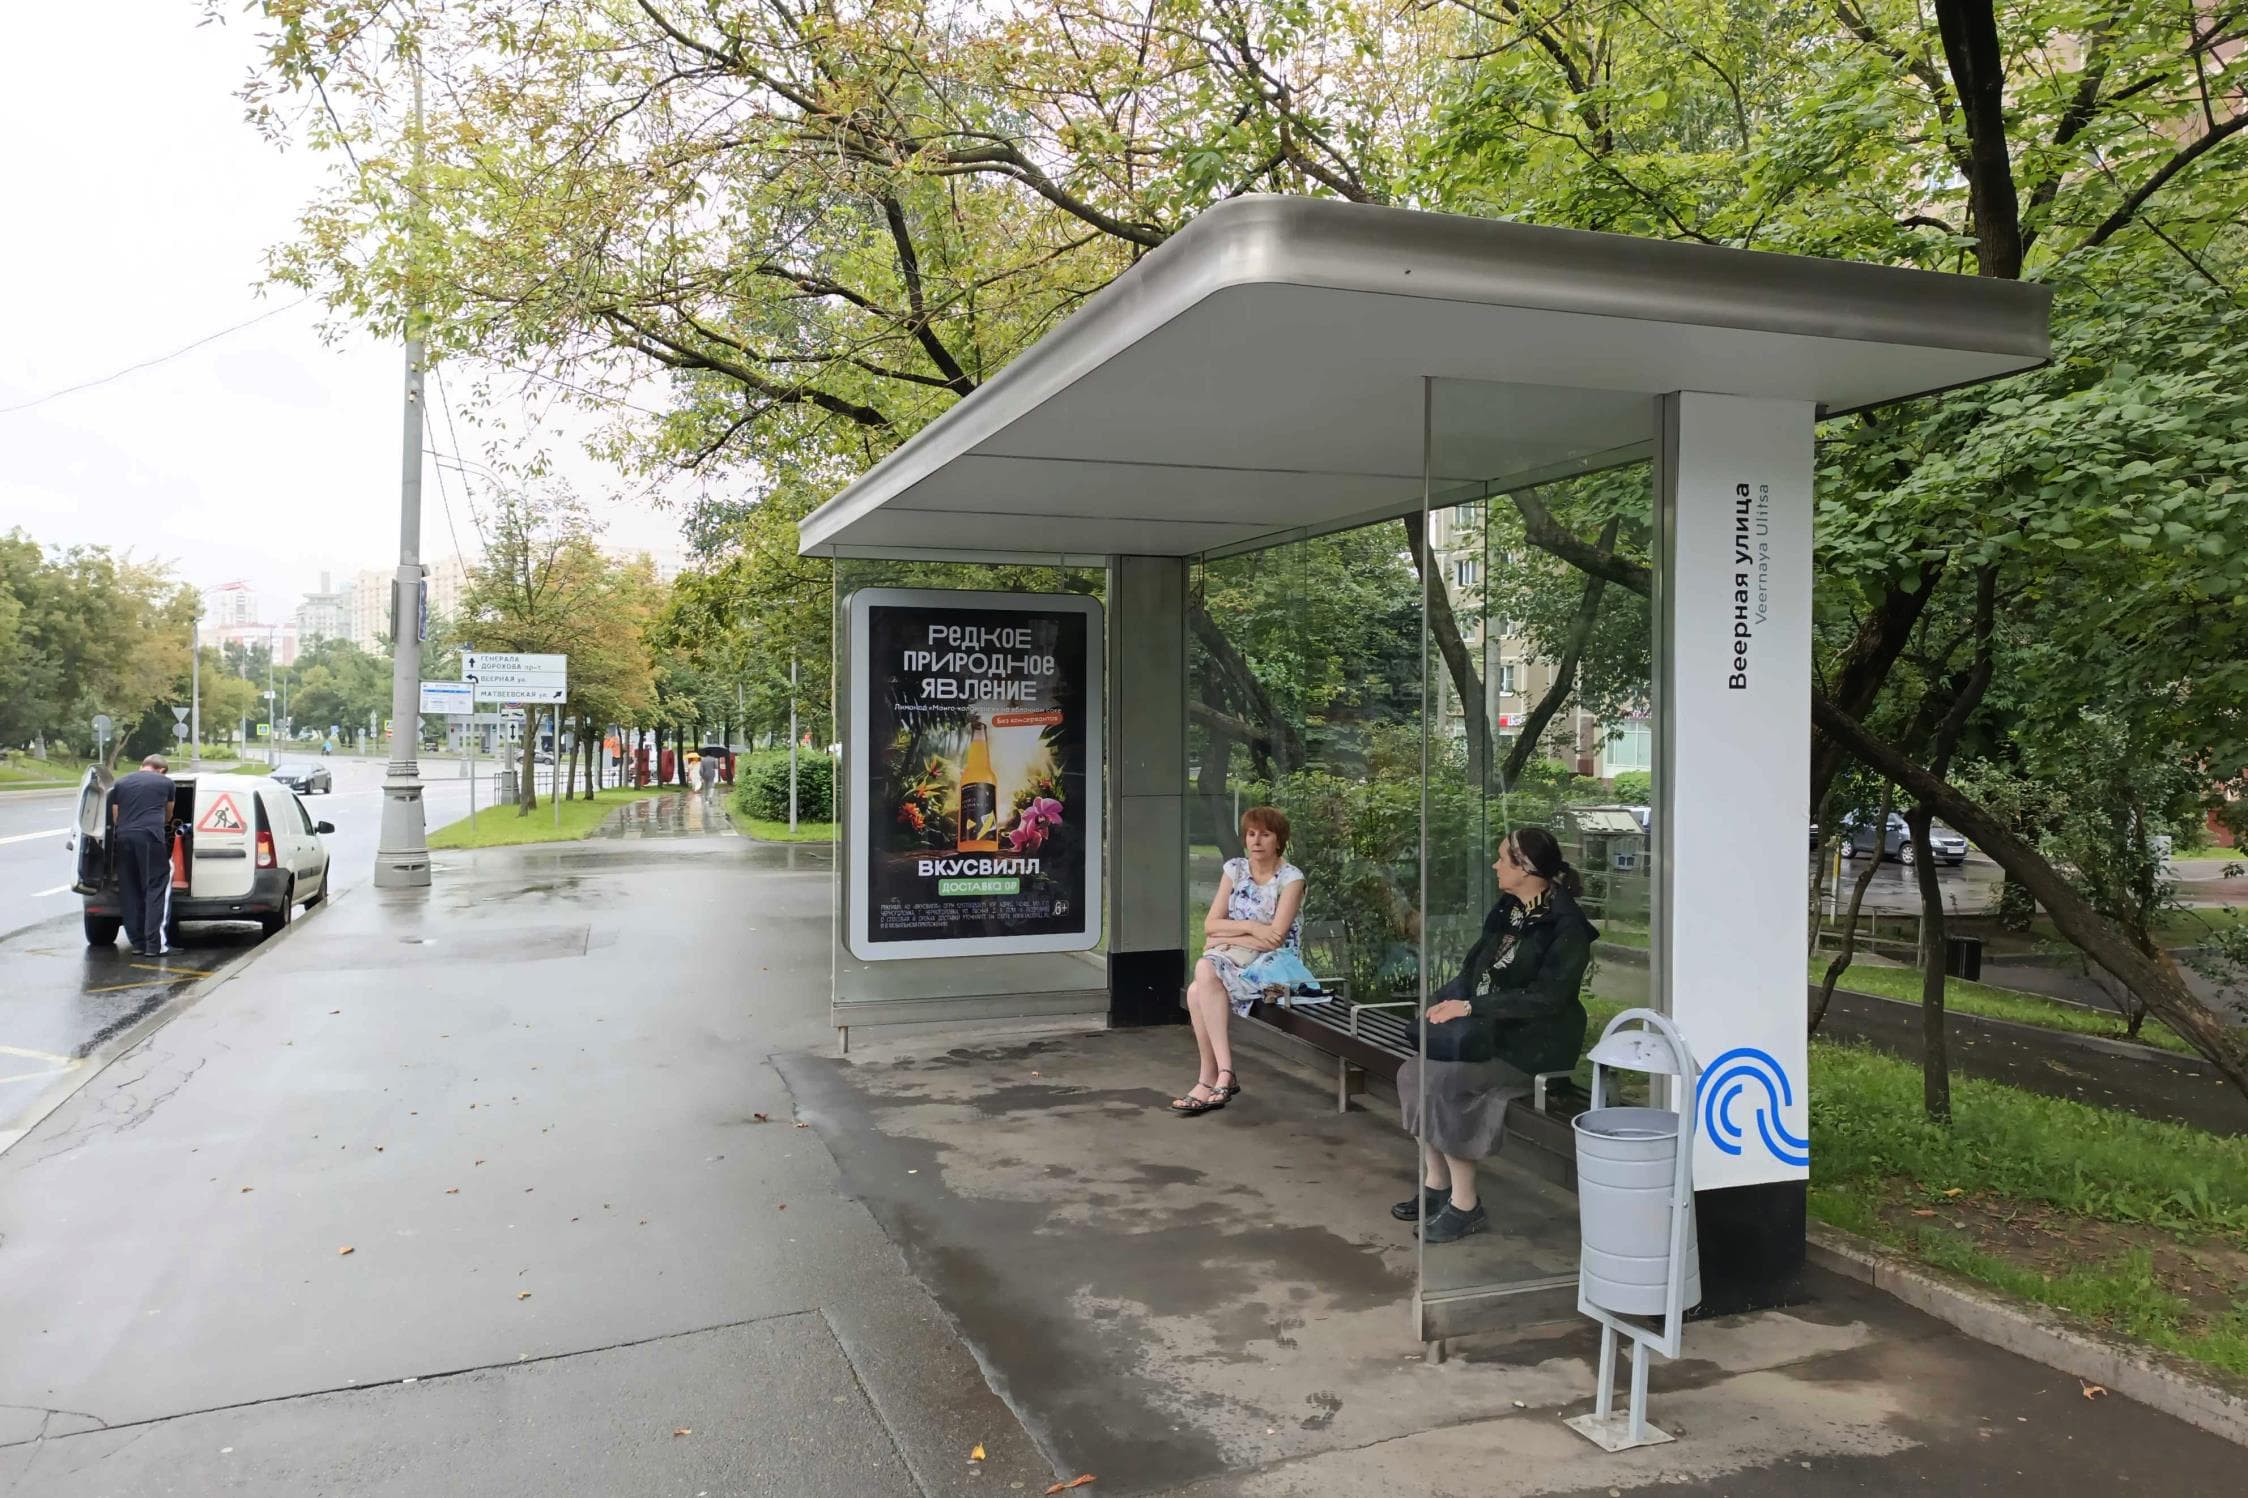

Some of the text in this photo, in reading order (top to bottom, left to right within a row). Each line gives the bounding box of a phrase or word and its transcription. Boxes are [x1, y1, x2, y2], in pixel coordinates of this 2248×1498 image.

[1729, 483, 1752, 689] Веерная улица
[1755, 484, 1770, 624] Veernaya Ulitsa
[918, 858, 1040, 877] ВКУСВИЛЛ
[1055, 901, 1068, 915] 6+
